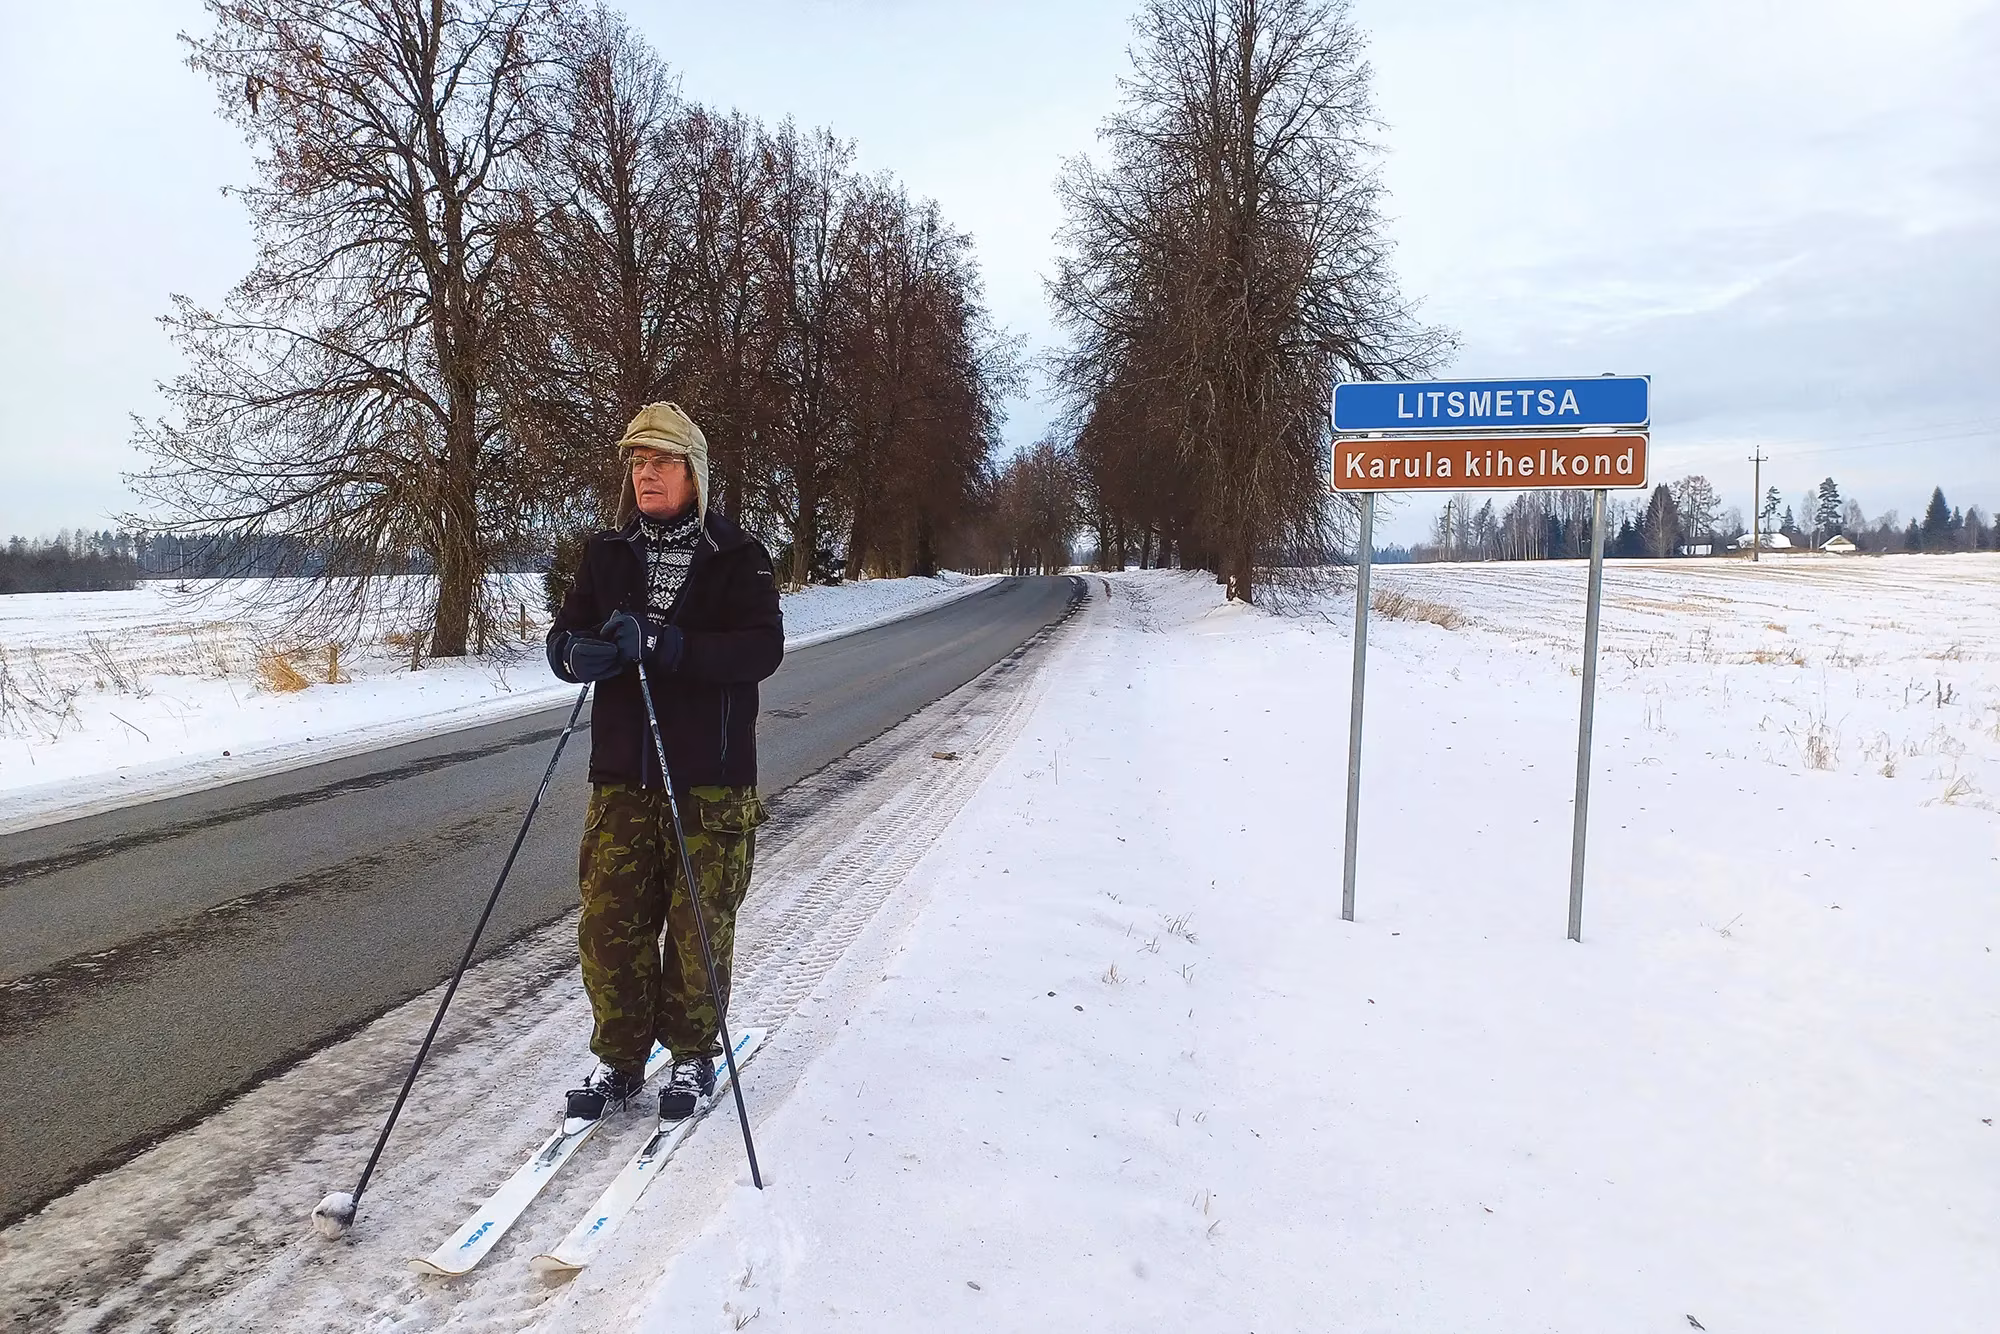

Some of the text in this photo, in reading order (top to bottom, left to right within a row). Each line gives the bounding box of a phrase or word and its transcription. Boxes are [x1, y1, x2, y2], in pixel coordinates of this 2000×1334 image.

[1397, 388, 1581, 419] LITSMETSA
[1345, 447, 1634, 479] Karula kihelkond
